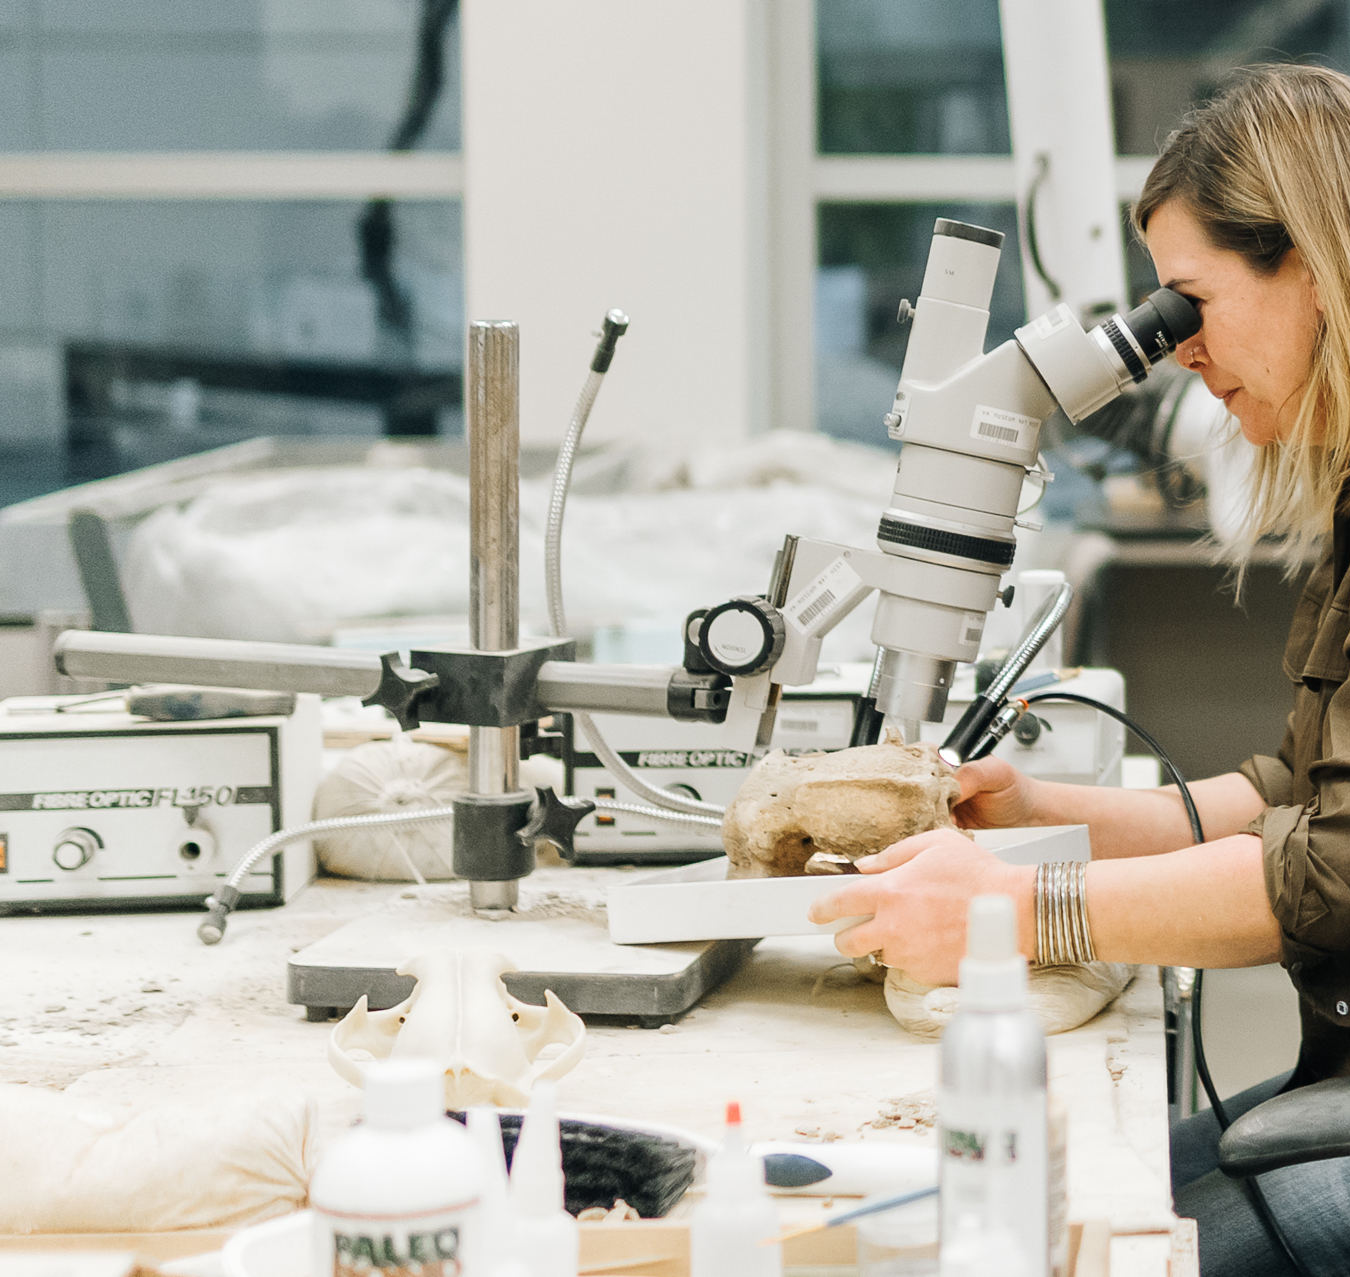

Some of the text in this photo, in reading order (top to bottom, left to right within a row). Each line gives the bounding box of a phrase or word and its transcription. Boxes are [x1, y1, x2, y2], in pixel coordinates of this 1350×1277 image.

[638, 751, 688, 767] FIBRE
[688, 750, 746, 767] OPTIC
[32, 792, 88, 809] FIBRE
[89, 790, 152, 808] OPTIC
[334, 1226, 460, 1268] PALEO
